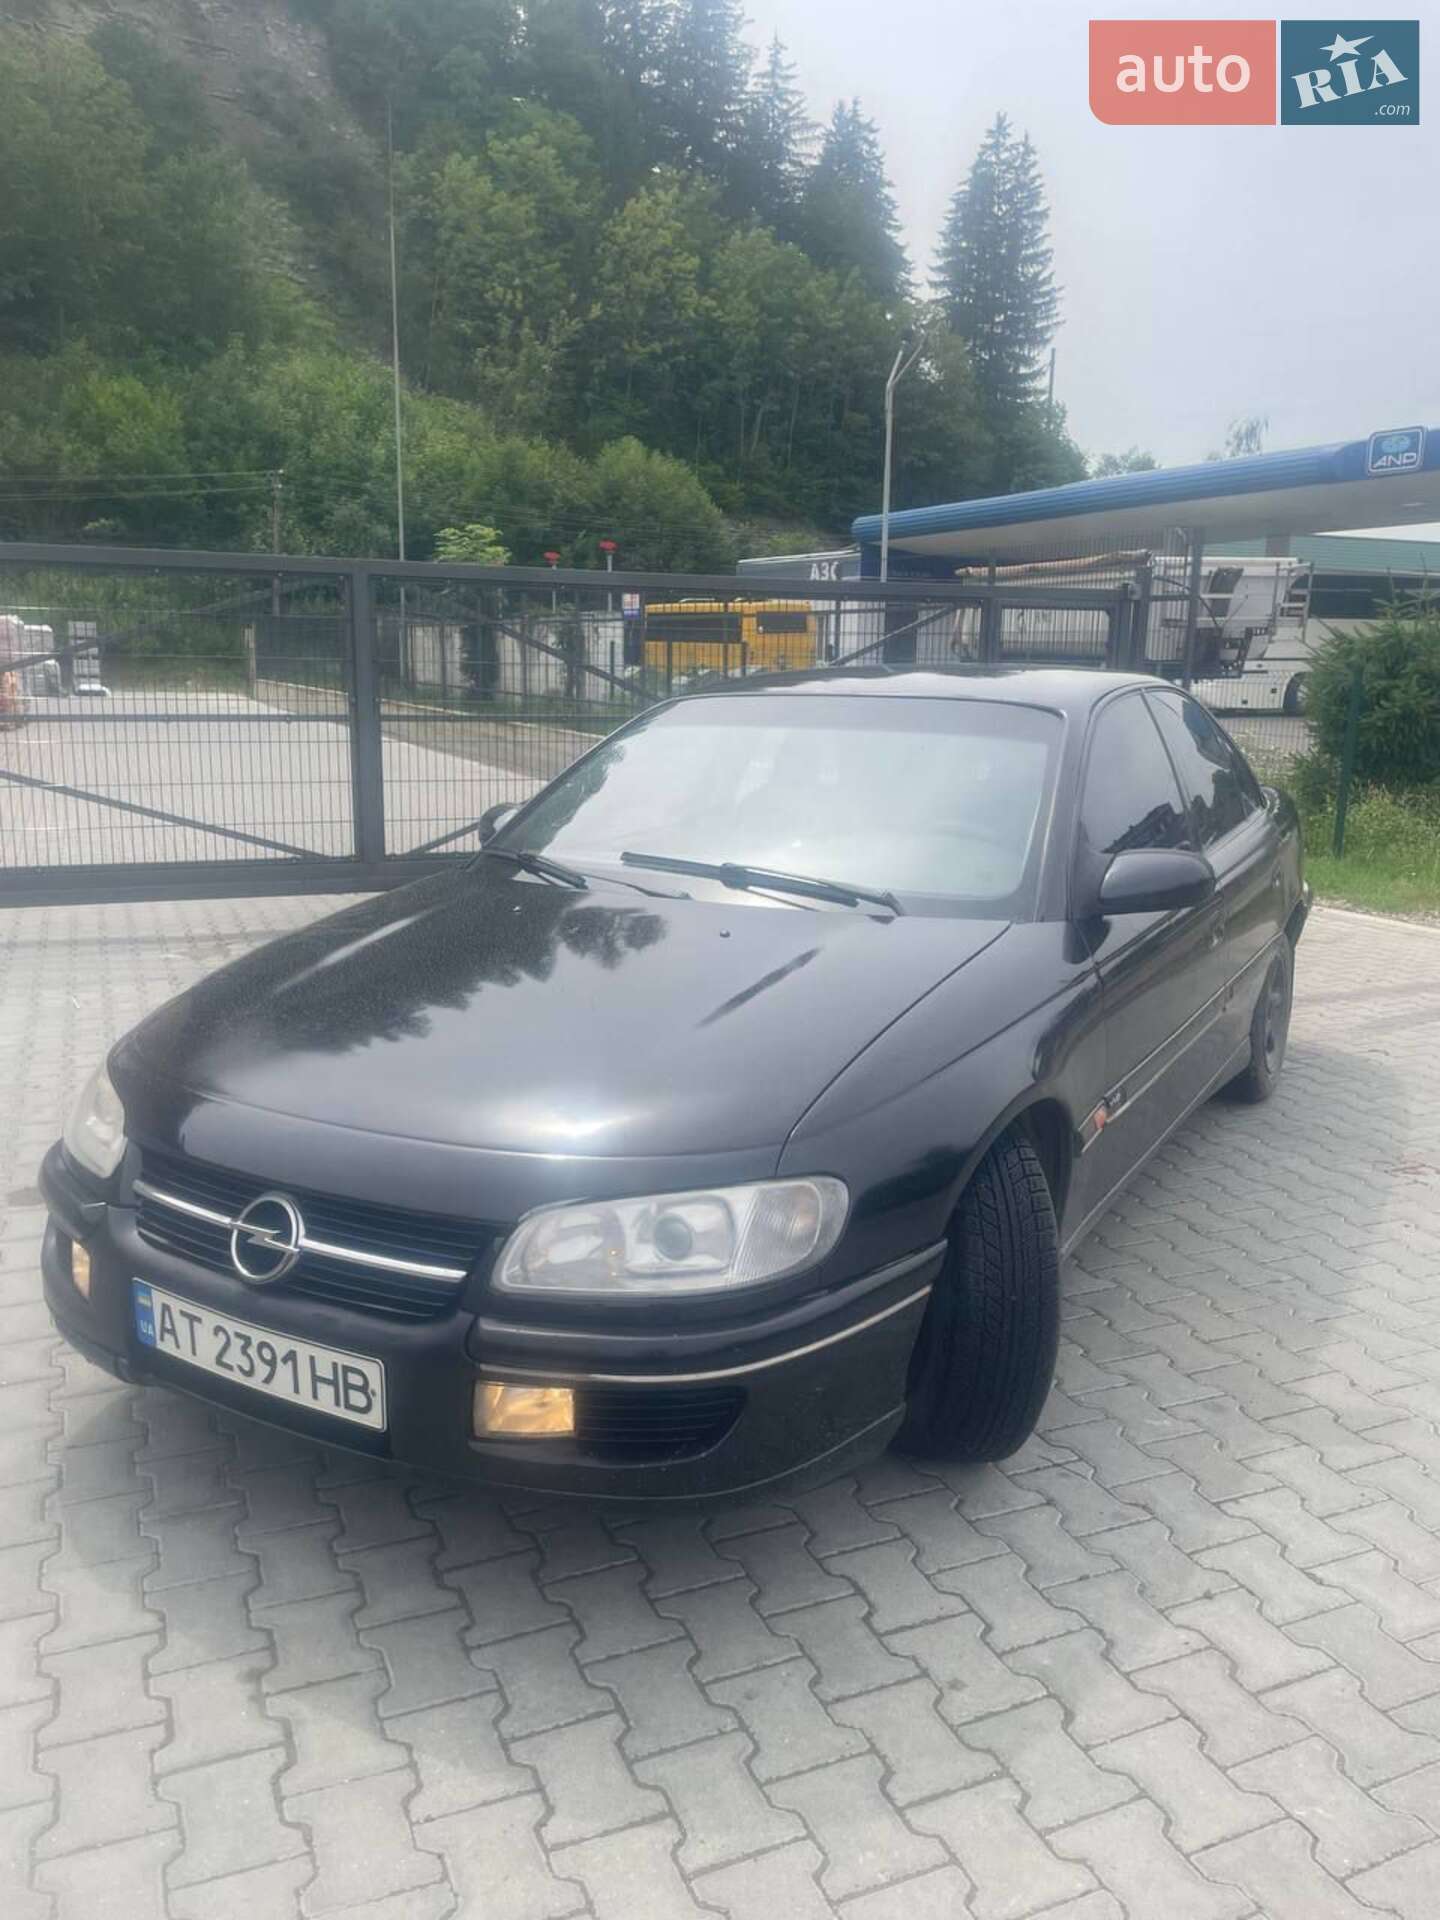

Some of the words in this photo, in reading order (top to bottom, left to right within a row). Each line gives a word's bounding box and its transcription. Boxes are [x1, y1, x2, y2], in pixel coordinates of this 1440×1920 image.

[159, 1302, 202, 1357] AT
[213, 1324, 300, 1395] 2391
[309, 1355, 373, 1415] HB
